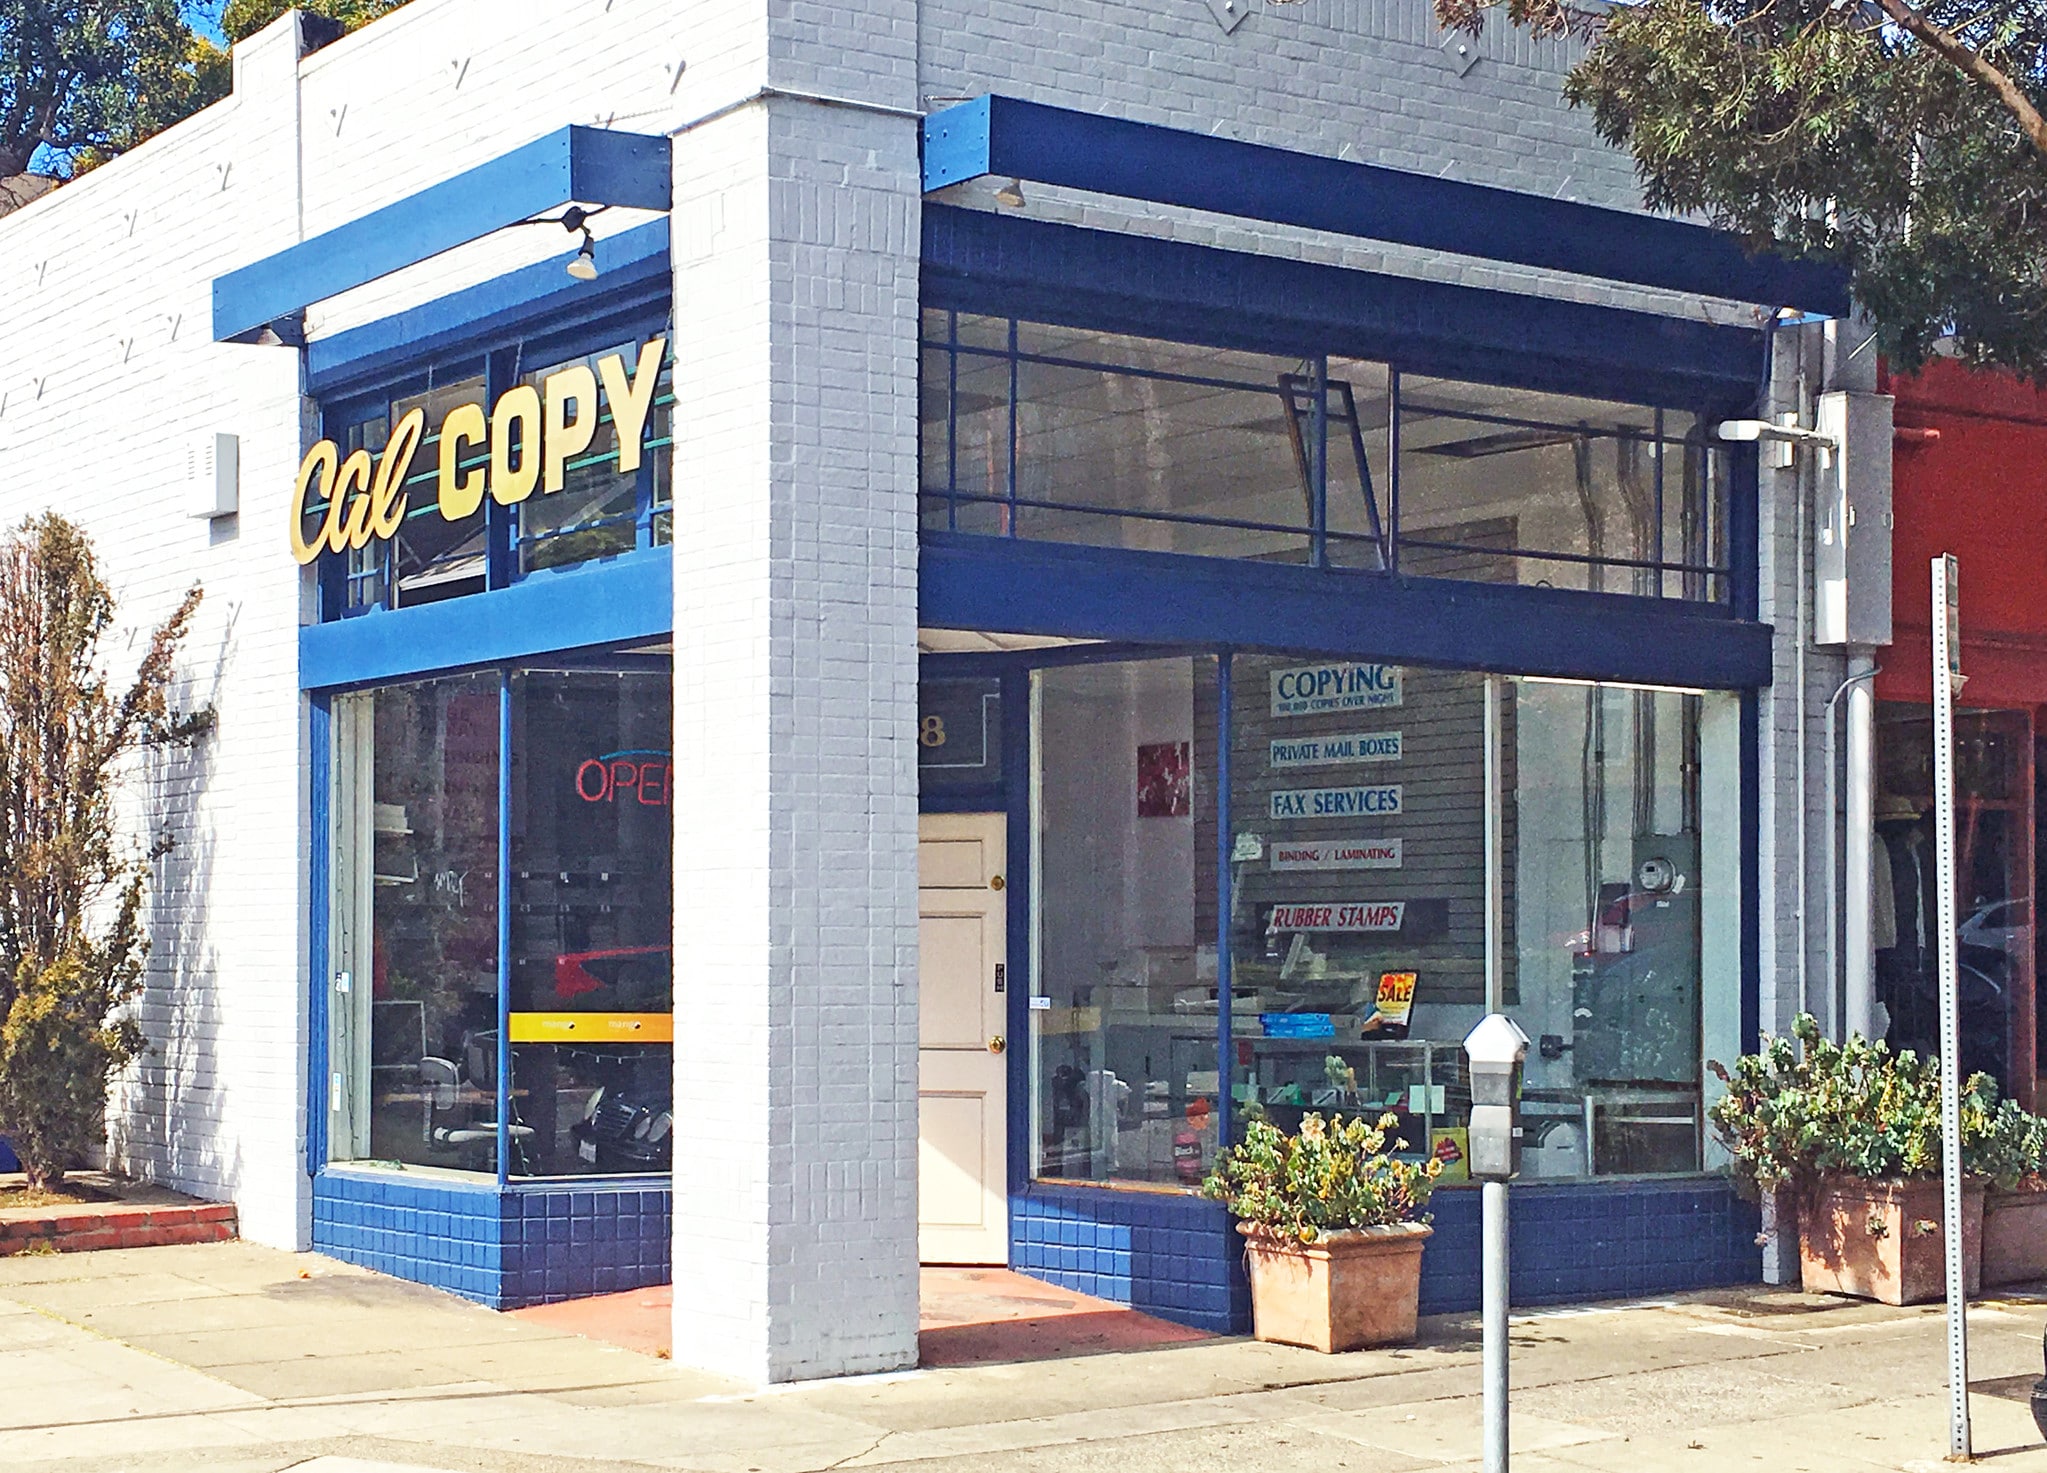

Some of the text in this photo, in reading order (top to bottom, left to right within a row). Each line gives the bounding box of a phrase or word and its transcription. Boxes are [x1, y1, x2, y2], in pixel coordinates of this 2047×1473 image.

[289, 337, 668, 566] Cal COPY
[1278, 664, 1394, 699] COPYING
[1272, 737, 1399, 762] PRIVATE MAIL BOXES
[1273, 788, 1398, 815] FAX SERVICES
[1278, 849, 1320, 862] BINDING
[1334, 846, 1396, 861] LAMINATING
[1273, 905, 1399, 928] RUBBER STAMPS
[1378, 983, 1411, 1003] SALE
